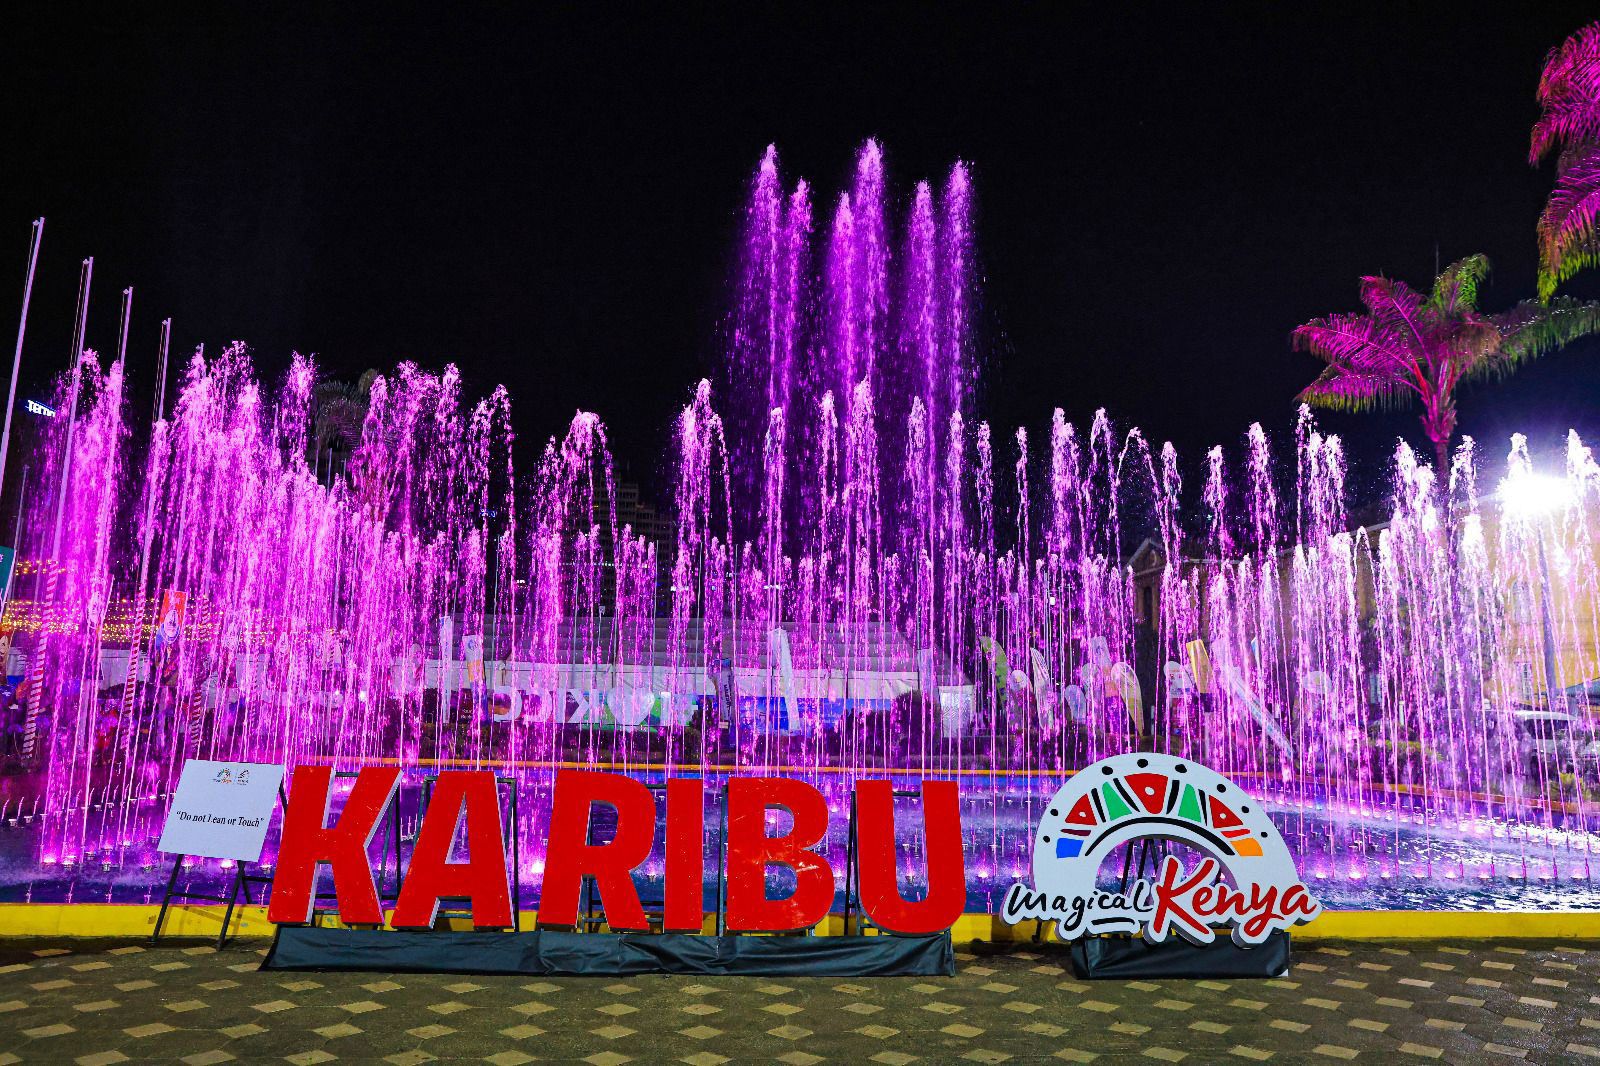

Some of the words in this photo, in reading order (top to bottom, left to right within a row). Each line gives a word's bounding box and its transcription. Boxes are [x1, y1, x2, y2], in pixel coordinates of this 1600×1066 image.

[192, 813, 206, 823] not
[207, 813, 226, 825] Lean
[228, 818, 237, 826] or
[267, 765, 967, 935] KARIBU
[1008, 882, 1154, 932] Magical
[1153, 857, 1318, 938] Kenya
